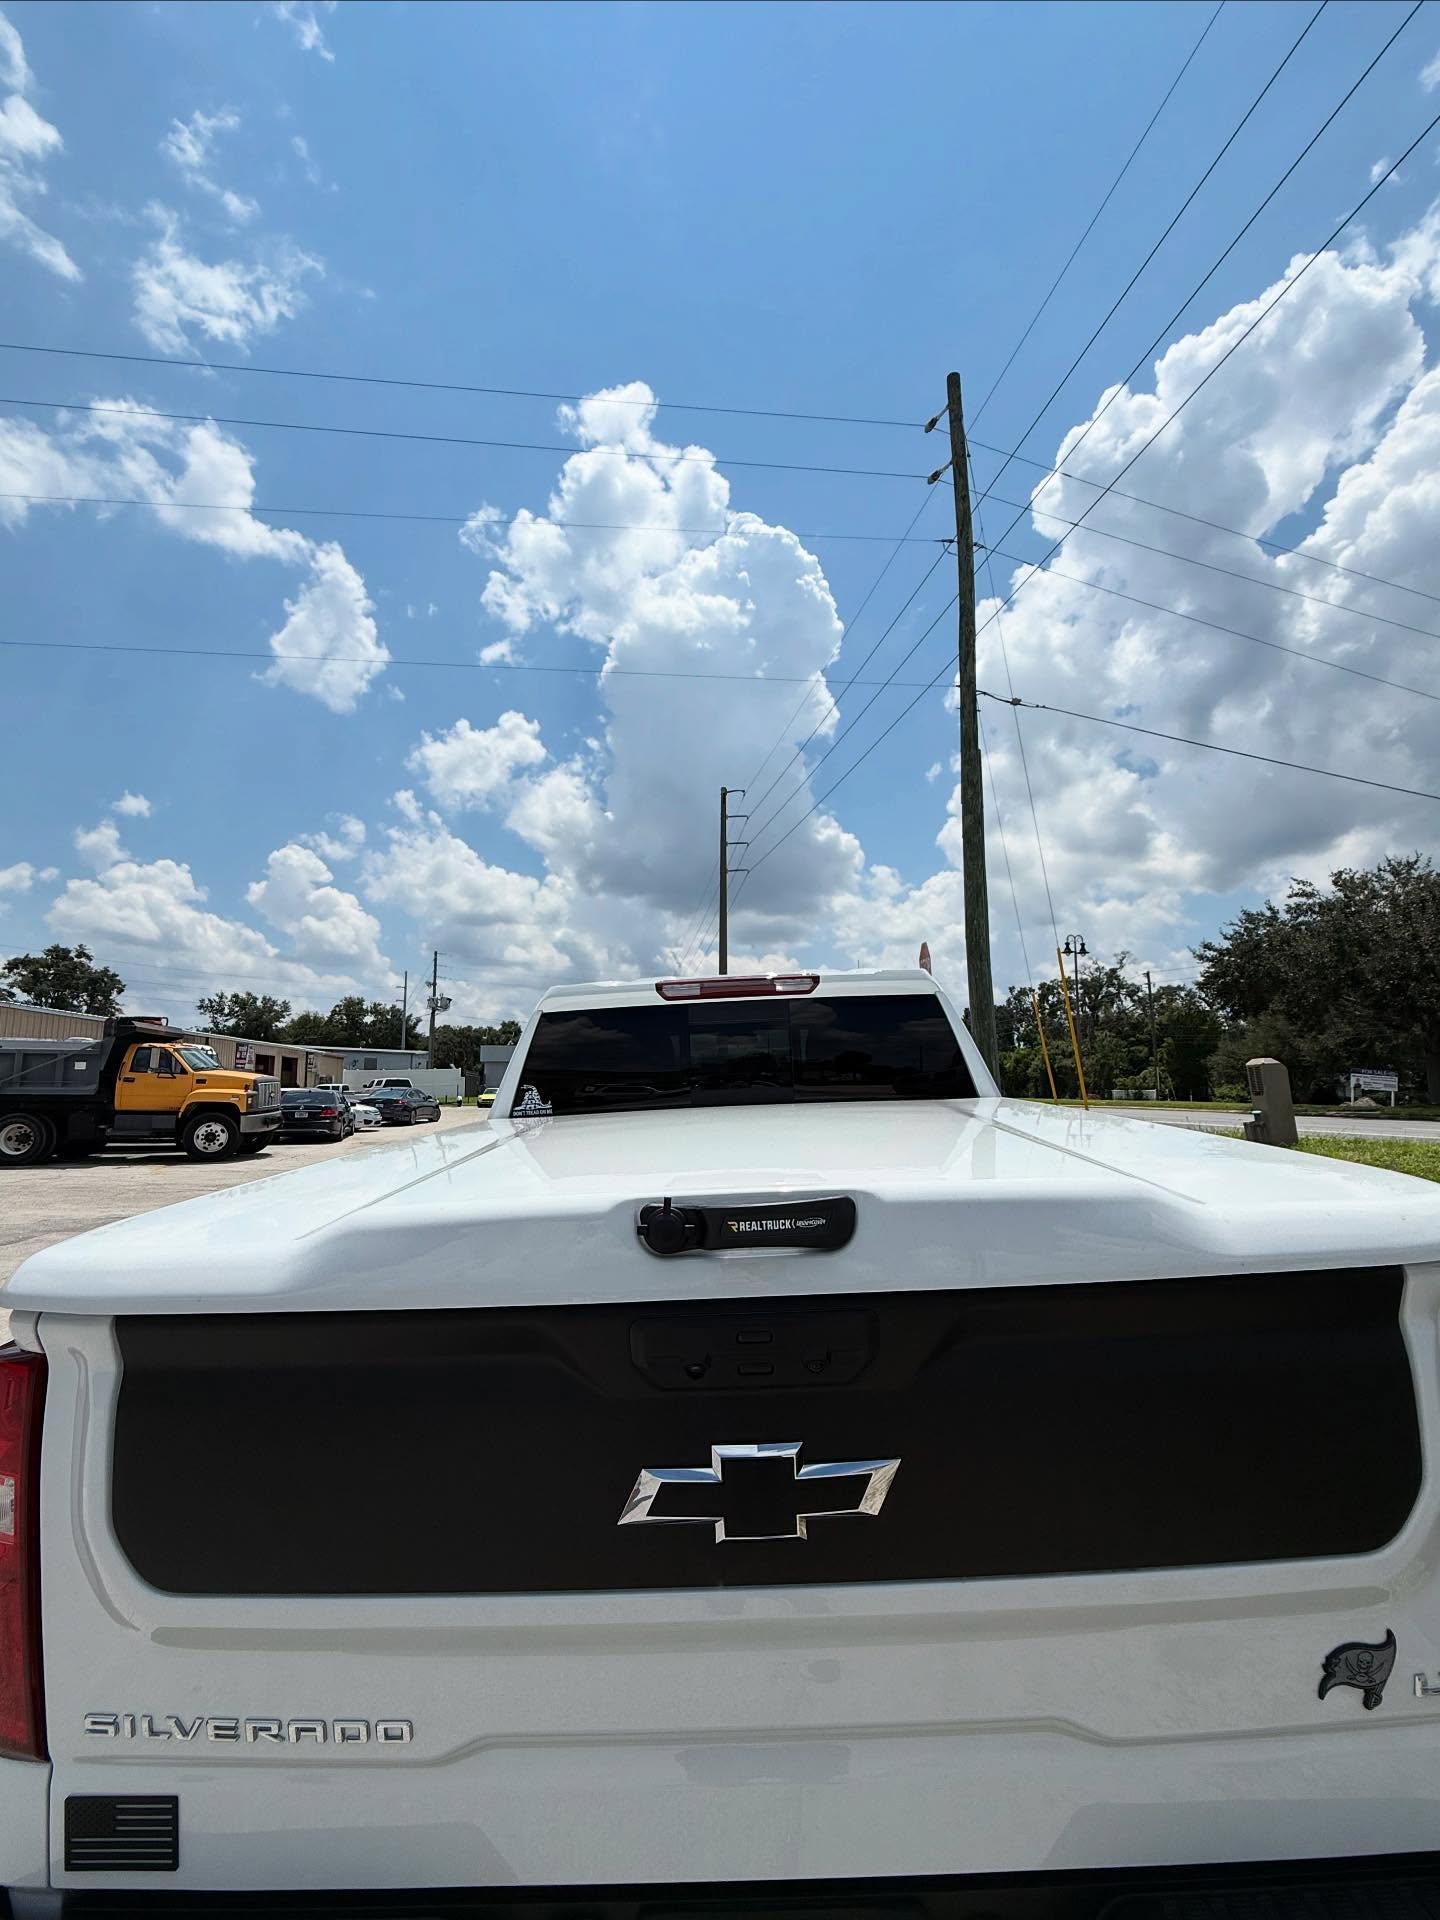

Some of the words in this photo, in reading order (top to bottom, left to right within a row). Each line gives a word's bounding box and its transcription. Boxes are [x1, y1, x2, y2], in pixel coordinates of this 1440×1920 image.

[739, 1219, 791, 1232] REALTRUCK
[1413, 1671, 1440, 1698] L
[83, 1712, 415, 1745] SILVERADO
